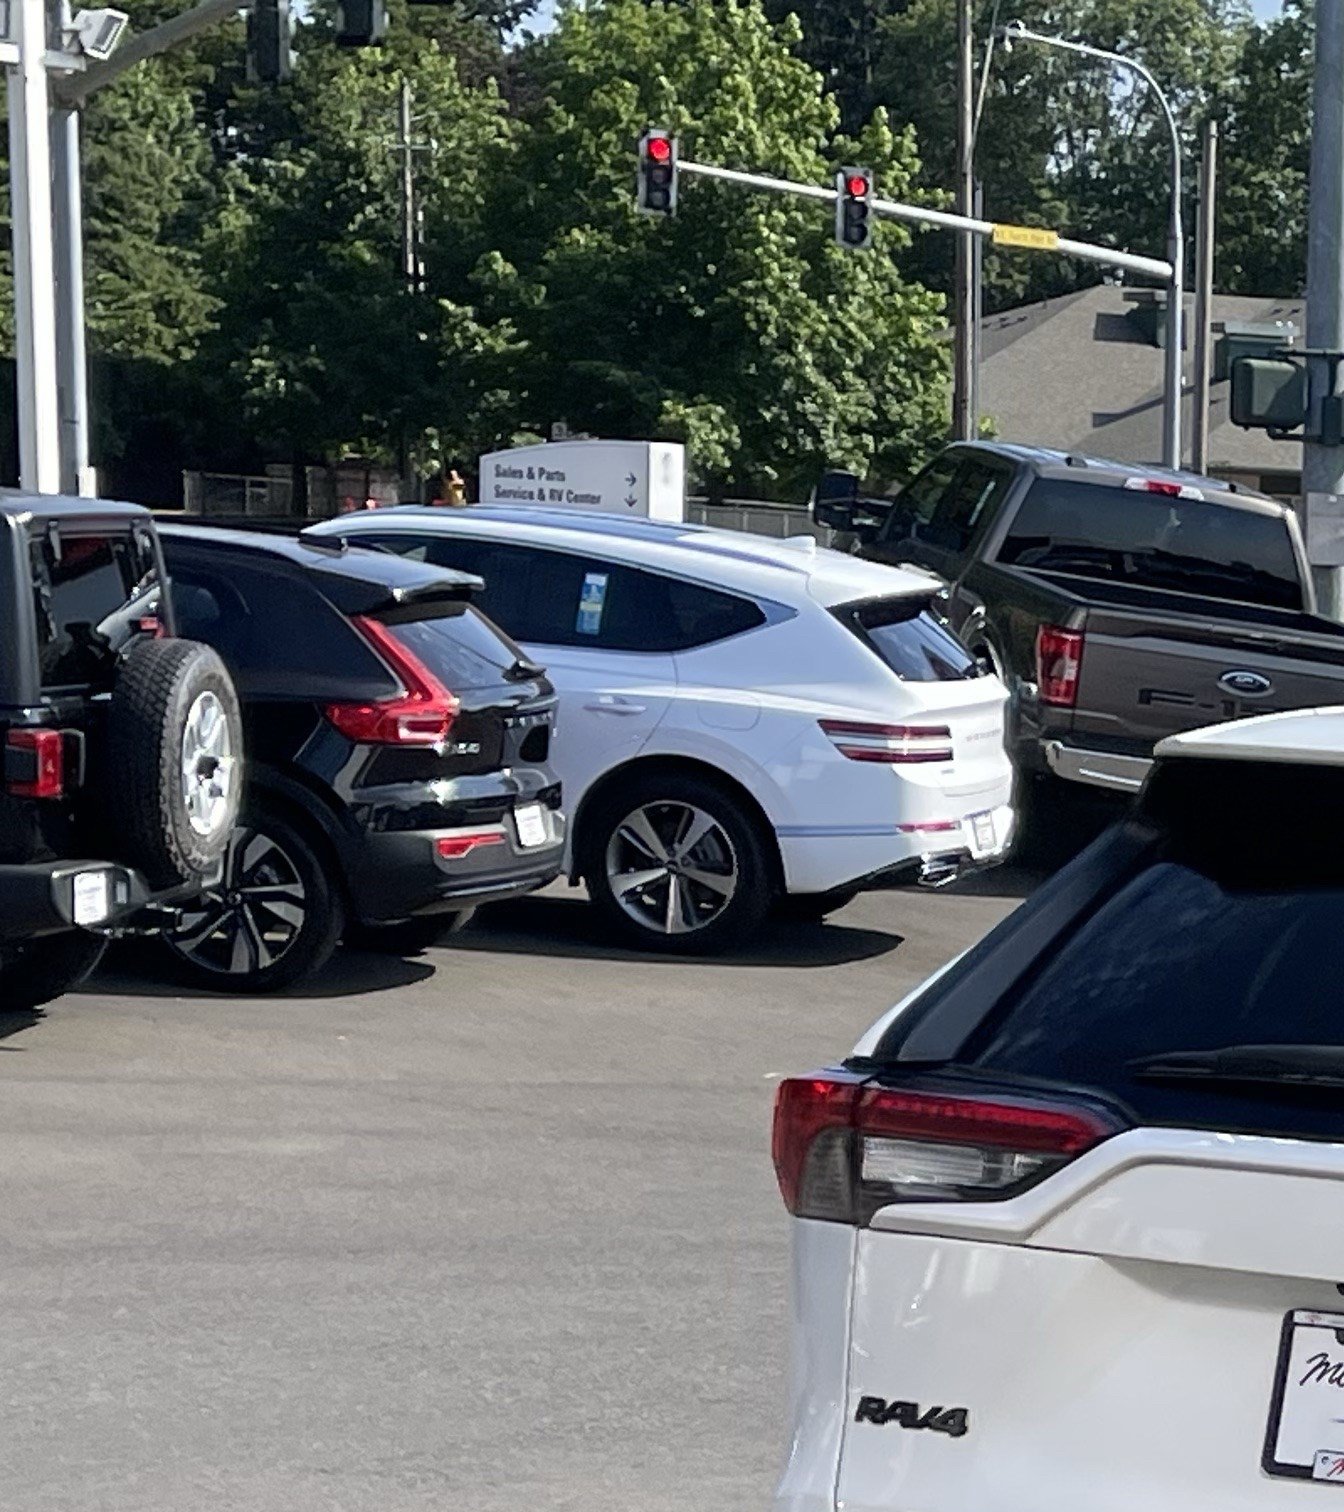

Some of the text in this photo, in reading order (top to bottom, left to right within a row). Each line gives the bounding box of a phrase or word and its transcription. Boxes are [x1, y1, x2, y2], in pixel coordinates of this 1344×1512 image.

[494, 463, 566, 482] Sales & Parts
[494, 483, 535, 501] Service
[537, 487, 546, 502] &
[566, 489, 602, 504] Center
[855, 1396, 968, 1438] RAV4
